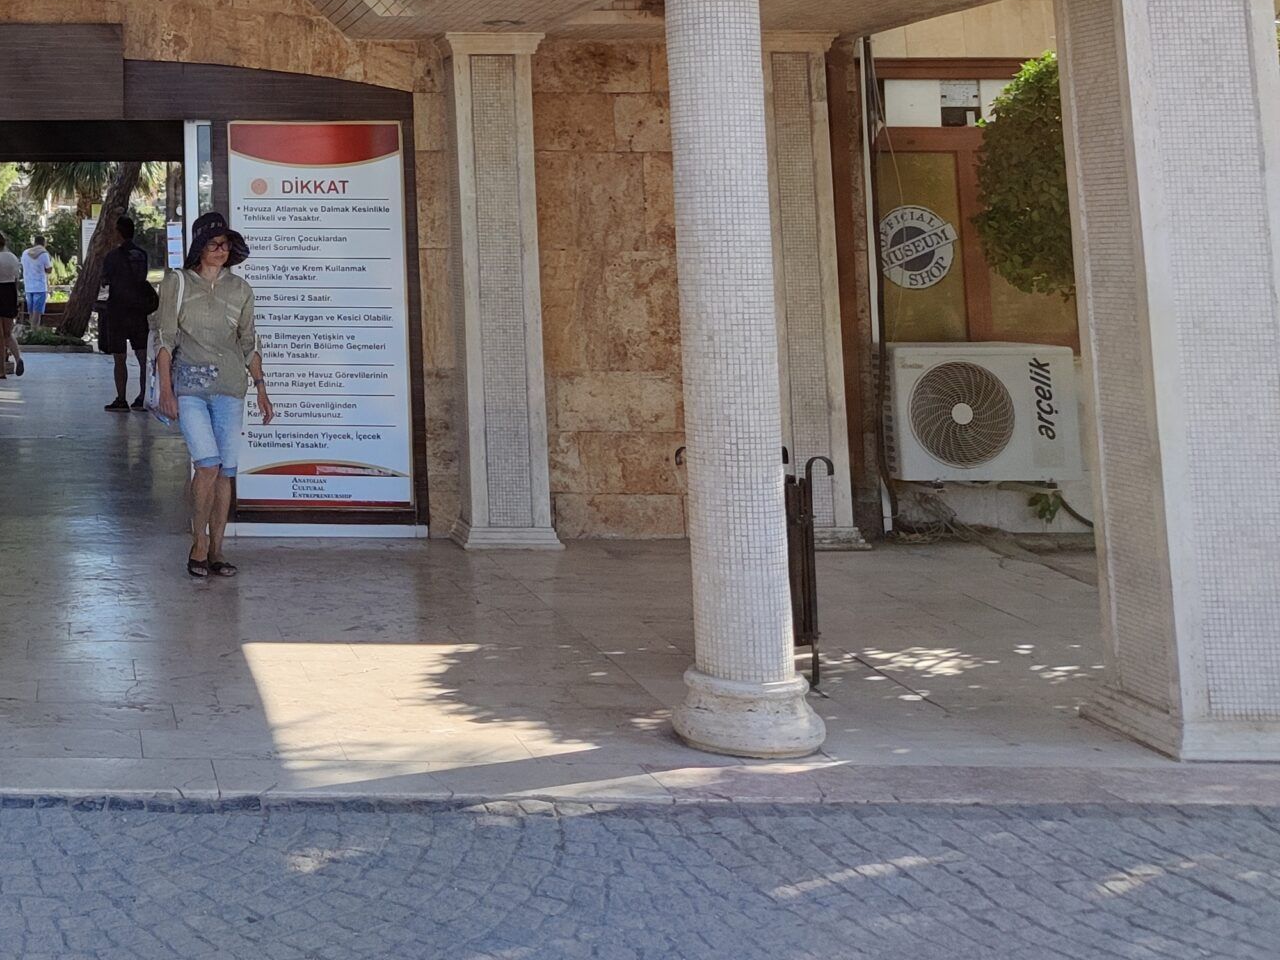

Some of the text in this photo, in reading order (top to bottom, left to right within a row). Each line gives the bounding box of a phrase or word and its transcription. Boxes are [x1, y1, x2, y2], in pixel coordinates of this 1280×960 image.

[281, 177, 349, 194] DİKKAT
[243, 205, 272, 213] Havuza
[275, 205, 308, 213] Atlamak
[320, 205, 350, 214] Dalmak
[351, 206, 390, 214] Kesinlikle
[243, 214, 276, 222] Tehlikeli
[880, 211, 936, 248] OFFICIAL
[243, 234, 348, 244] Havuza Giren Çocuklardan
[248, 243, 271, 251] ileleri
[881, 228, 950, 266] MUSEUM
[244, 264, 270, 273] Güneş
[271, 264, 289, 274] Yağı
[302, 264, 323, 272] Krem
[325, 264, 367, 272] Kullanmak
[908, 256, 947, 287] SHOP
[244, 273, 283, 281] Kesinlikle
[273, 294, 299, 302] Süresi
[300, 294, 306, 302] 2
[269, 313, 291, 322] Taşlar
[293, 313, 324, 323] Kaygan
[337, 313, 361, 322] Kesici
[274, 332, 311, 342] Bilmeyen
[312, 332, 344, 342] Yetişkin
[261, 342, 386, 352] ukların Derin Bölüme Geçmeleri
[308, 371, 333, 379] Havuz
[291, 380, 316, 389] Riayet
[1028, 356, 1057, 440] arçelik
[299, 400, 357, 410] Güvenliğinden
[247, 431, 273, 440] Suyun
[274, 430, 319, 440] İçerisinden
[355, 431, 382, 441] İçecek
[247, 440, 294, 449] Tüketilmesi
